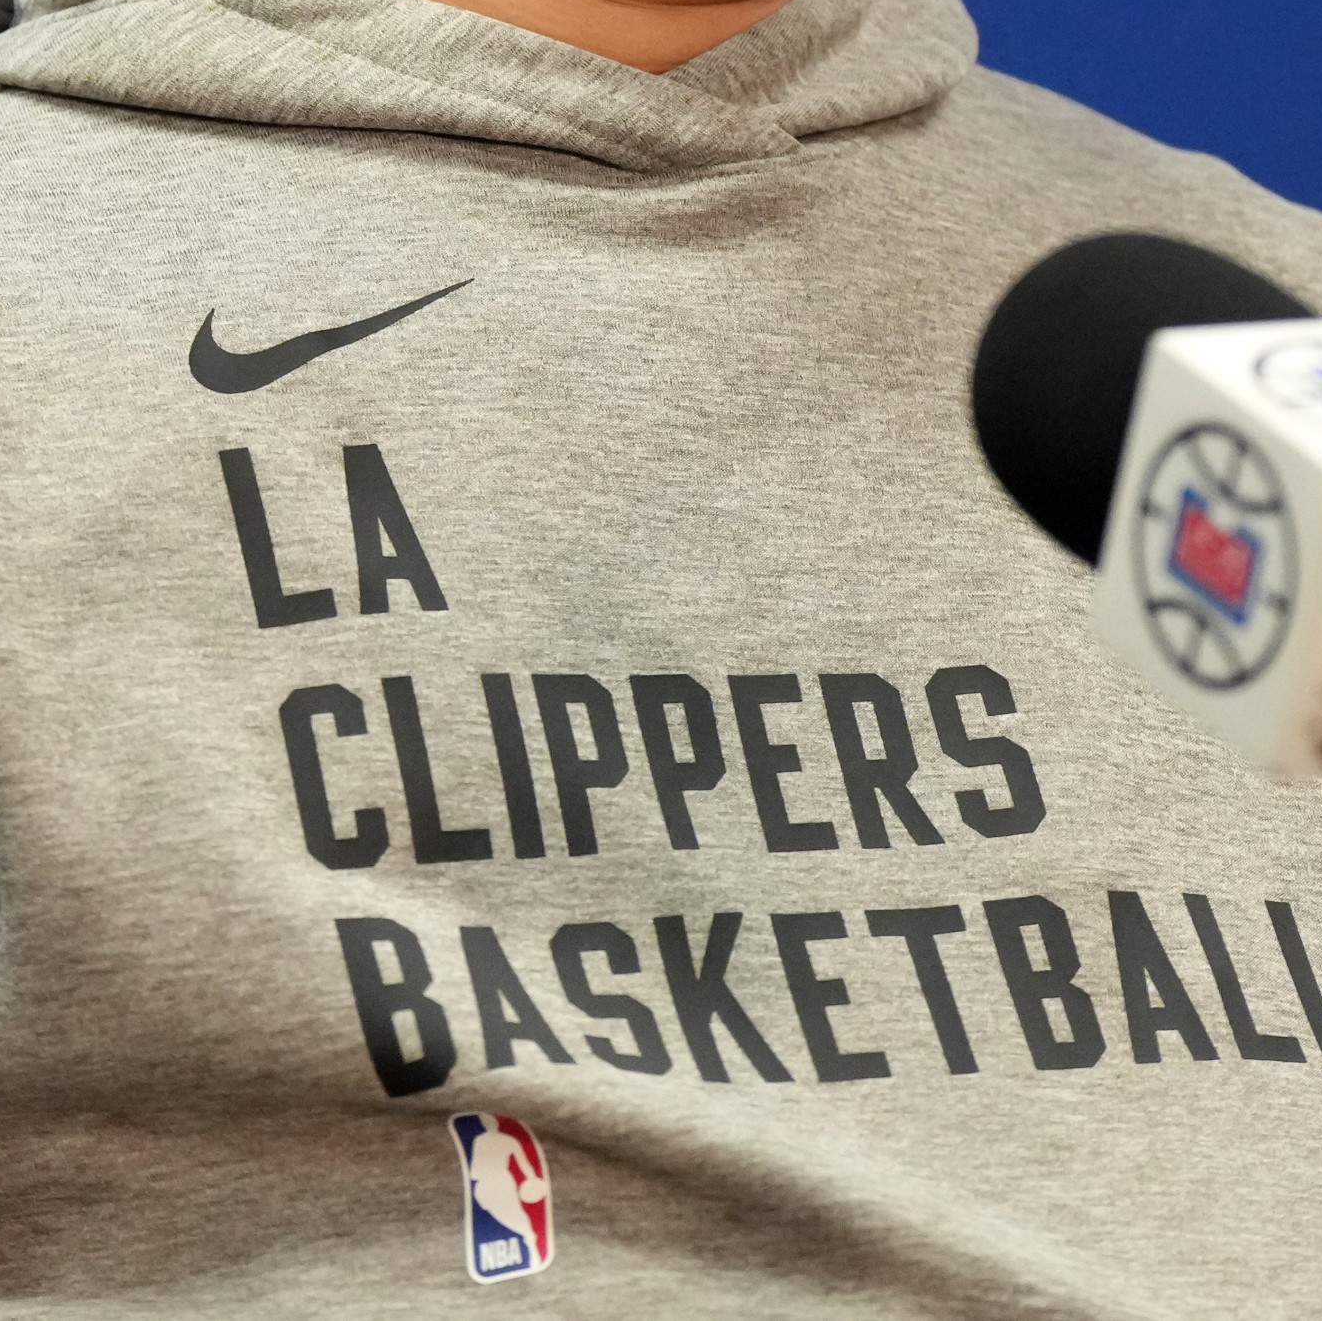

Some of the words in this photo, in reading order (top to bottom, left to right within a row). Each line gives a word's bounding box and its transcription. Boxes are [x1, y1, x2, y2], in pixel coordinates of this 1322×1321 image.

[218, 442, 449, 629] LA
[278, 663, 1048, 870] CLIPPERS
[479, 1237, 523, 1272] NBA
